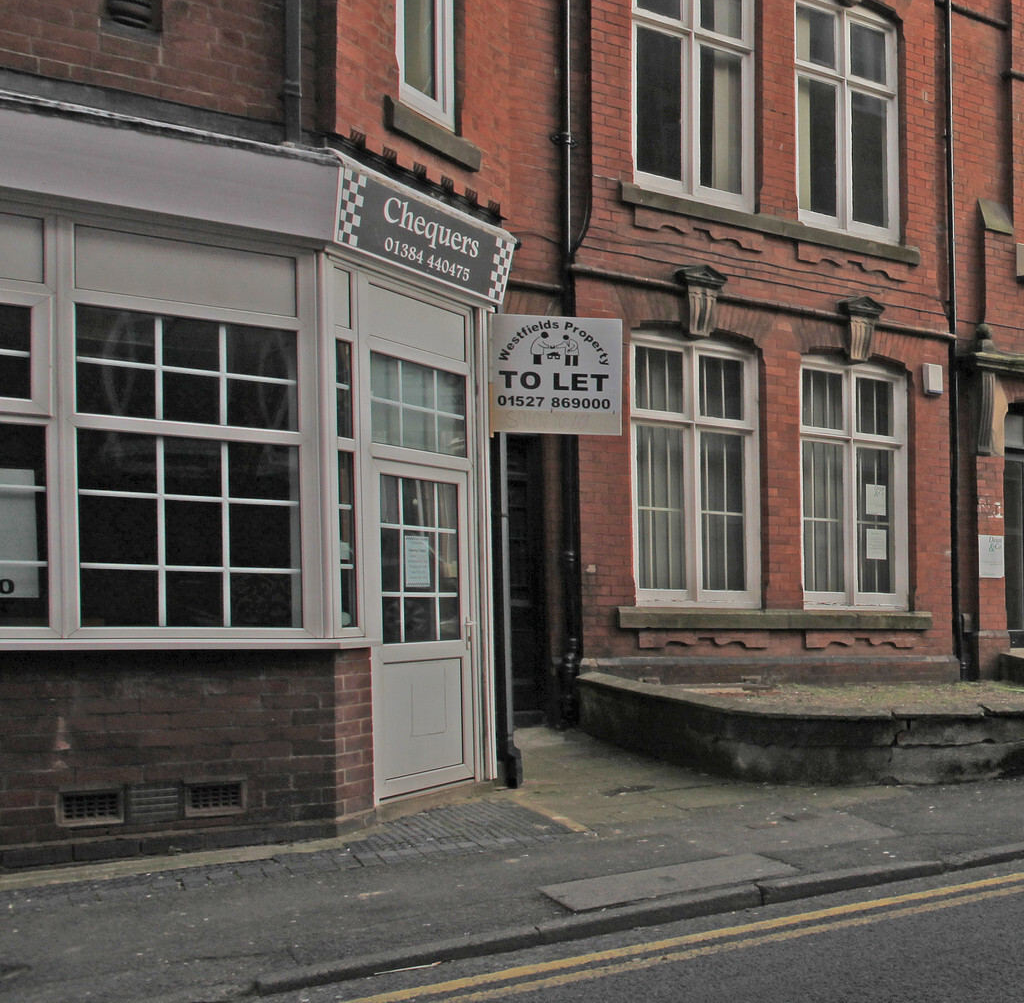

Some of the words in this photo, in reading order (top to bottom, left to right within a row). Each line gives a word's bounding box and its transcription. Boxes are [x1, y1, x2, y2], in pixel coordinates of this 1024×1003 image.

[383, 197, 480, 258] Chequers
[384, 237, 424, 263] 01384
[427, 253, 470, 282] 440475
[498, 320, 560, 362] Westfields
[564, 321, 610, 366] Property
[497, 395, 545, 408] 01527
[551, 397, 611, 410] 869000
[499, 371, 541, 390] TO
[553, 373, 609, 392] LET
